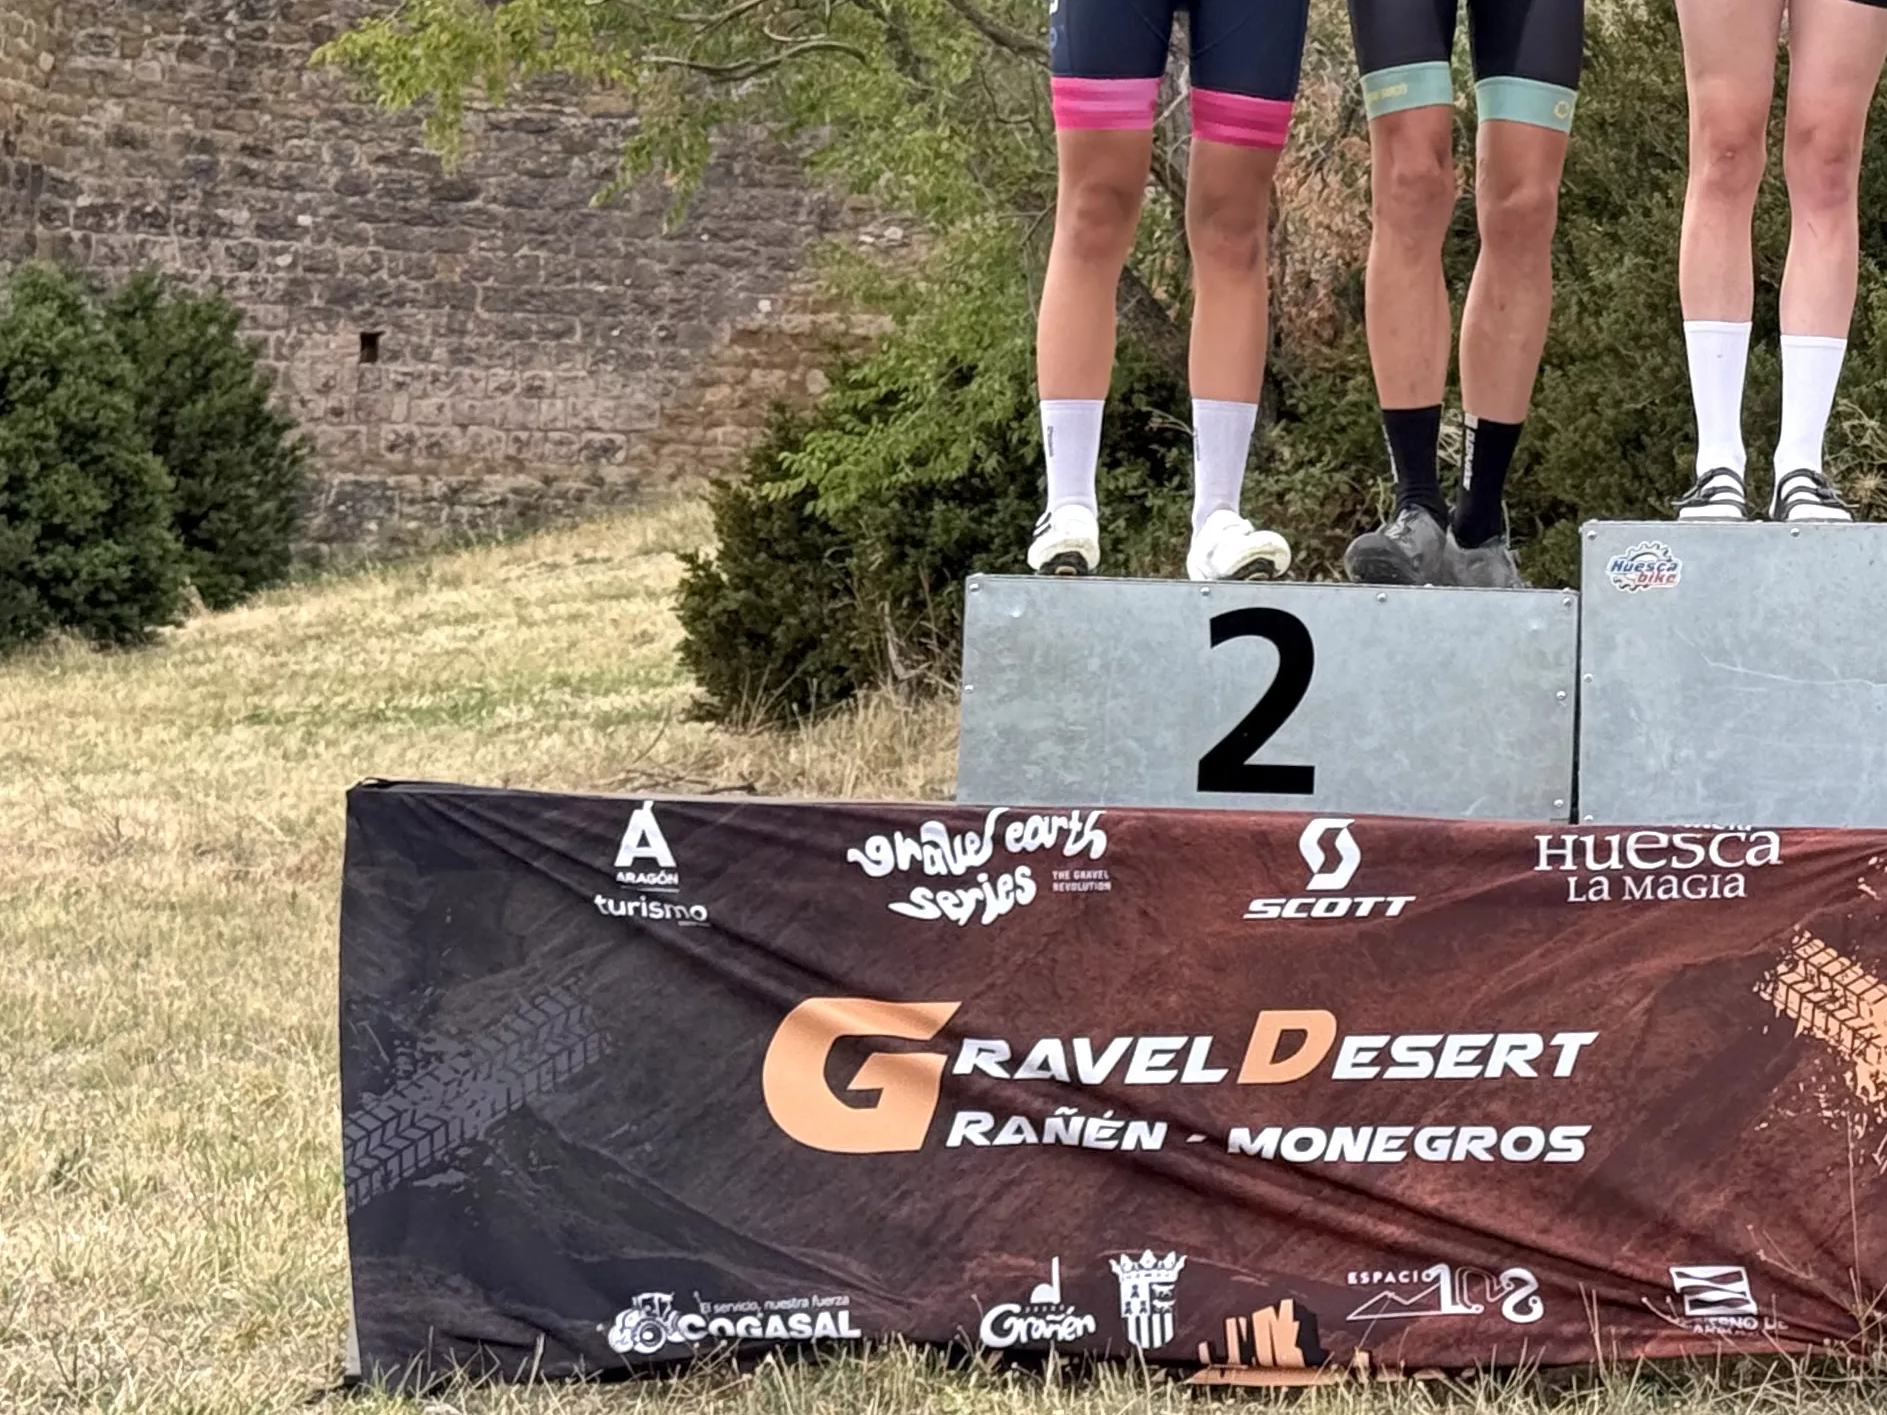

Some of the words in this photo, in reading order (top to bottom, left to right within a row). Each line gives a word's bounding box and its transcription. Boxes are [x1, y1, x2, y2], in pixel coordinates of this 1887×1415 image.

[1610, 560, 1678, 573] Huesca
[1196, 607, 1316, 796] 2
[846, 807, 1011, 878] gravel
[1005, 810, 1108, 860] earth
[616, 870, 679, 886] ARAGÓN
[1052, 870, 1071, 881] THE
[1073, 869, 1109, 881] GRAVEL
[1052, 881, 1112, 893] REVOLUTION
[593, 894, 708, 922] turismo
[888, 865, 1037, 927] series
[1243, 896, 1417, 919] SCOTT
[762, 996, 1230, 1154] GRAVEL
[1236, 1010, 1600, 1085] DESERT
[1227, 1124, 1593, 1163] MONEGROS
[1347, 1269, 1434, 1285] ESPACIO
[713, 1301, 762, 1315] servicio,
[764, 1296, 809, 1311] nuestra
[812, 1294, 850, 1309] fuerza
[677, 1310, 862, 1340] COGASAL
[980, 1303, 1096, 1348] Grañén
